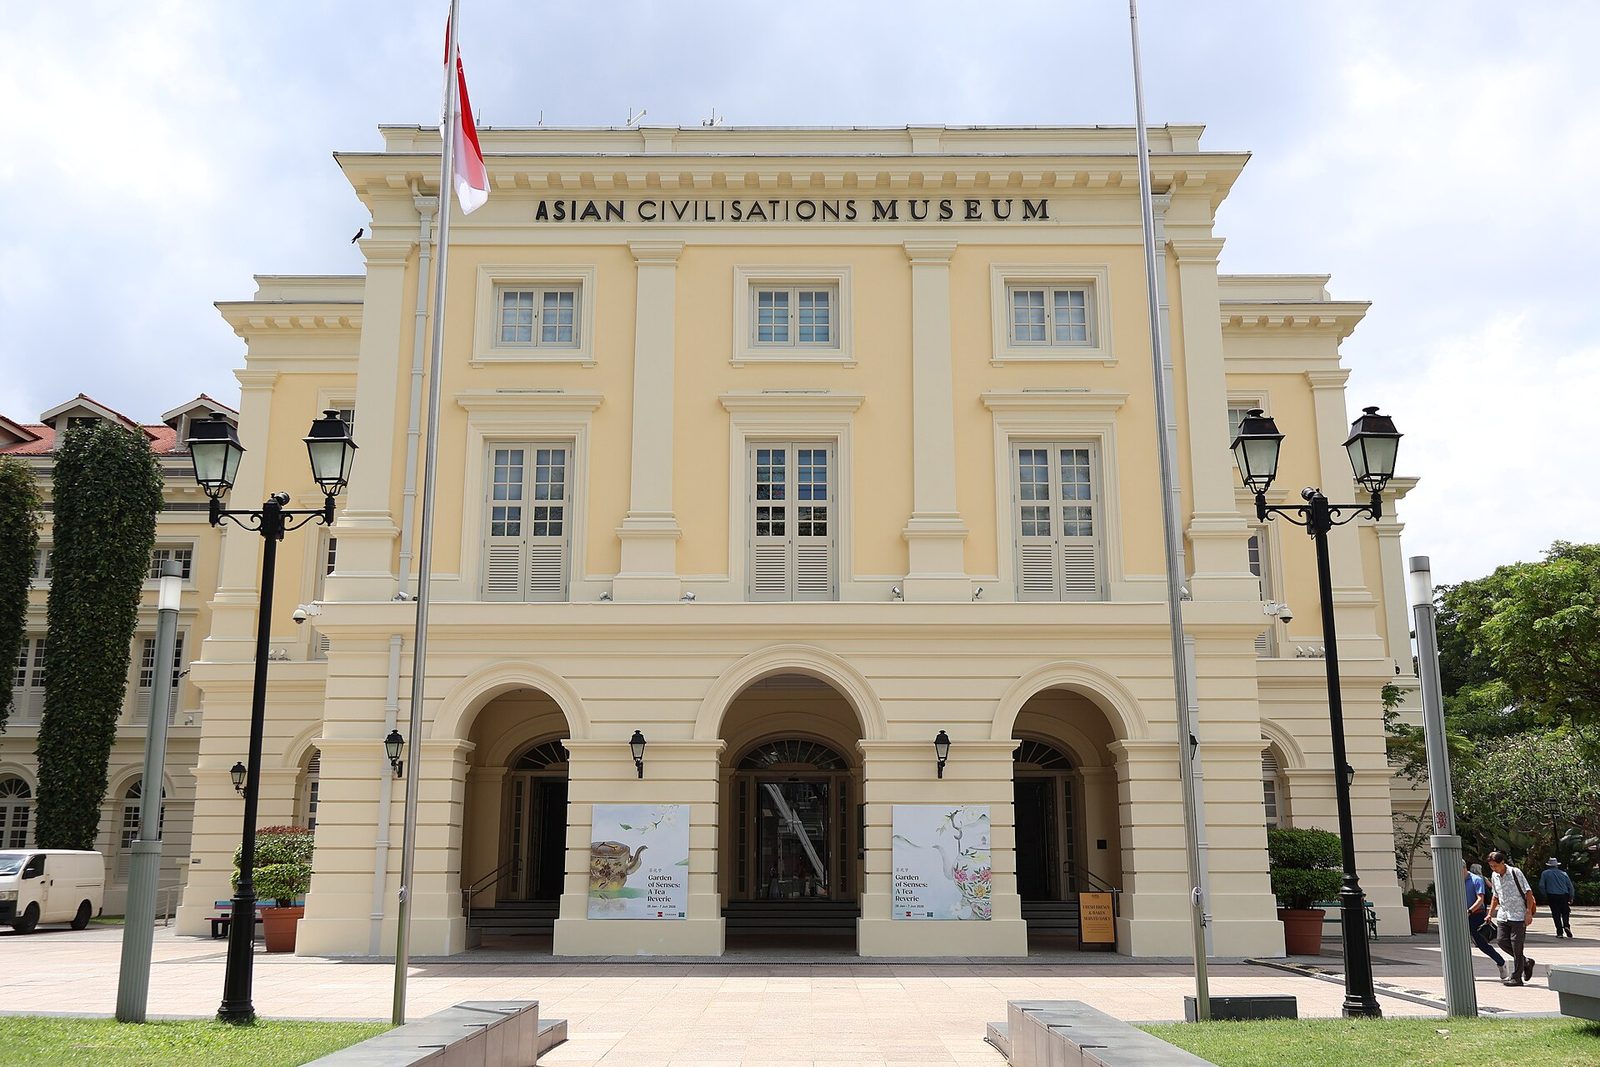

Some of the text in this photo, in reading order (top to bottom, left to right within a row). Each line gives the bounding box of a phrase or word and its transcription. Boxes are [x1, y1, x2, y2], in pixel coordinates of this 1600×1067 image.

[535, 199, 1050, 221] ASIAN CIVILISATIONS MUSEUM
